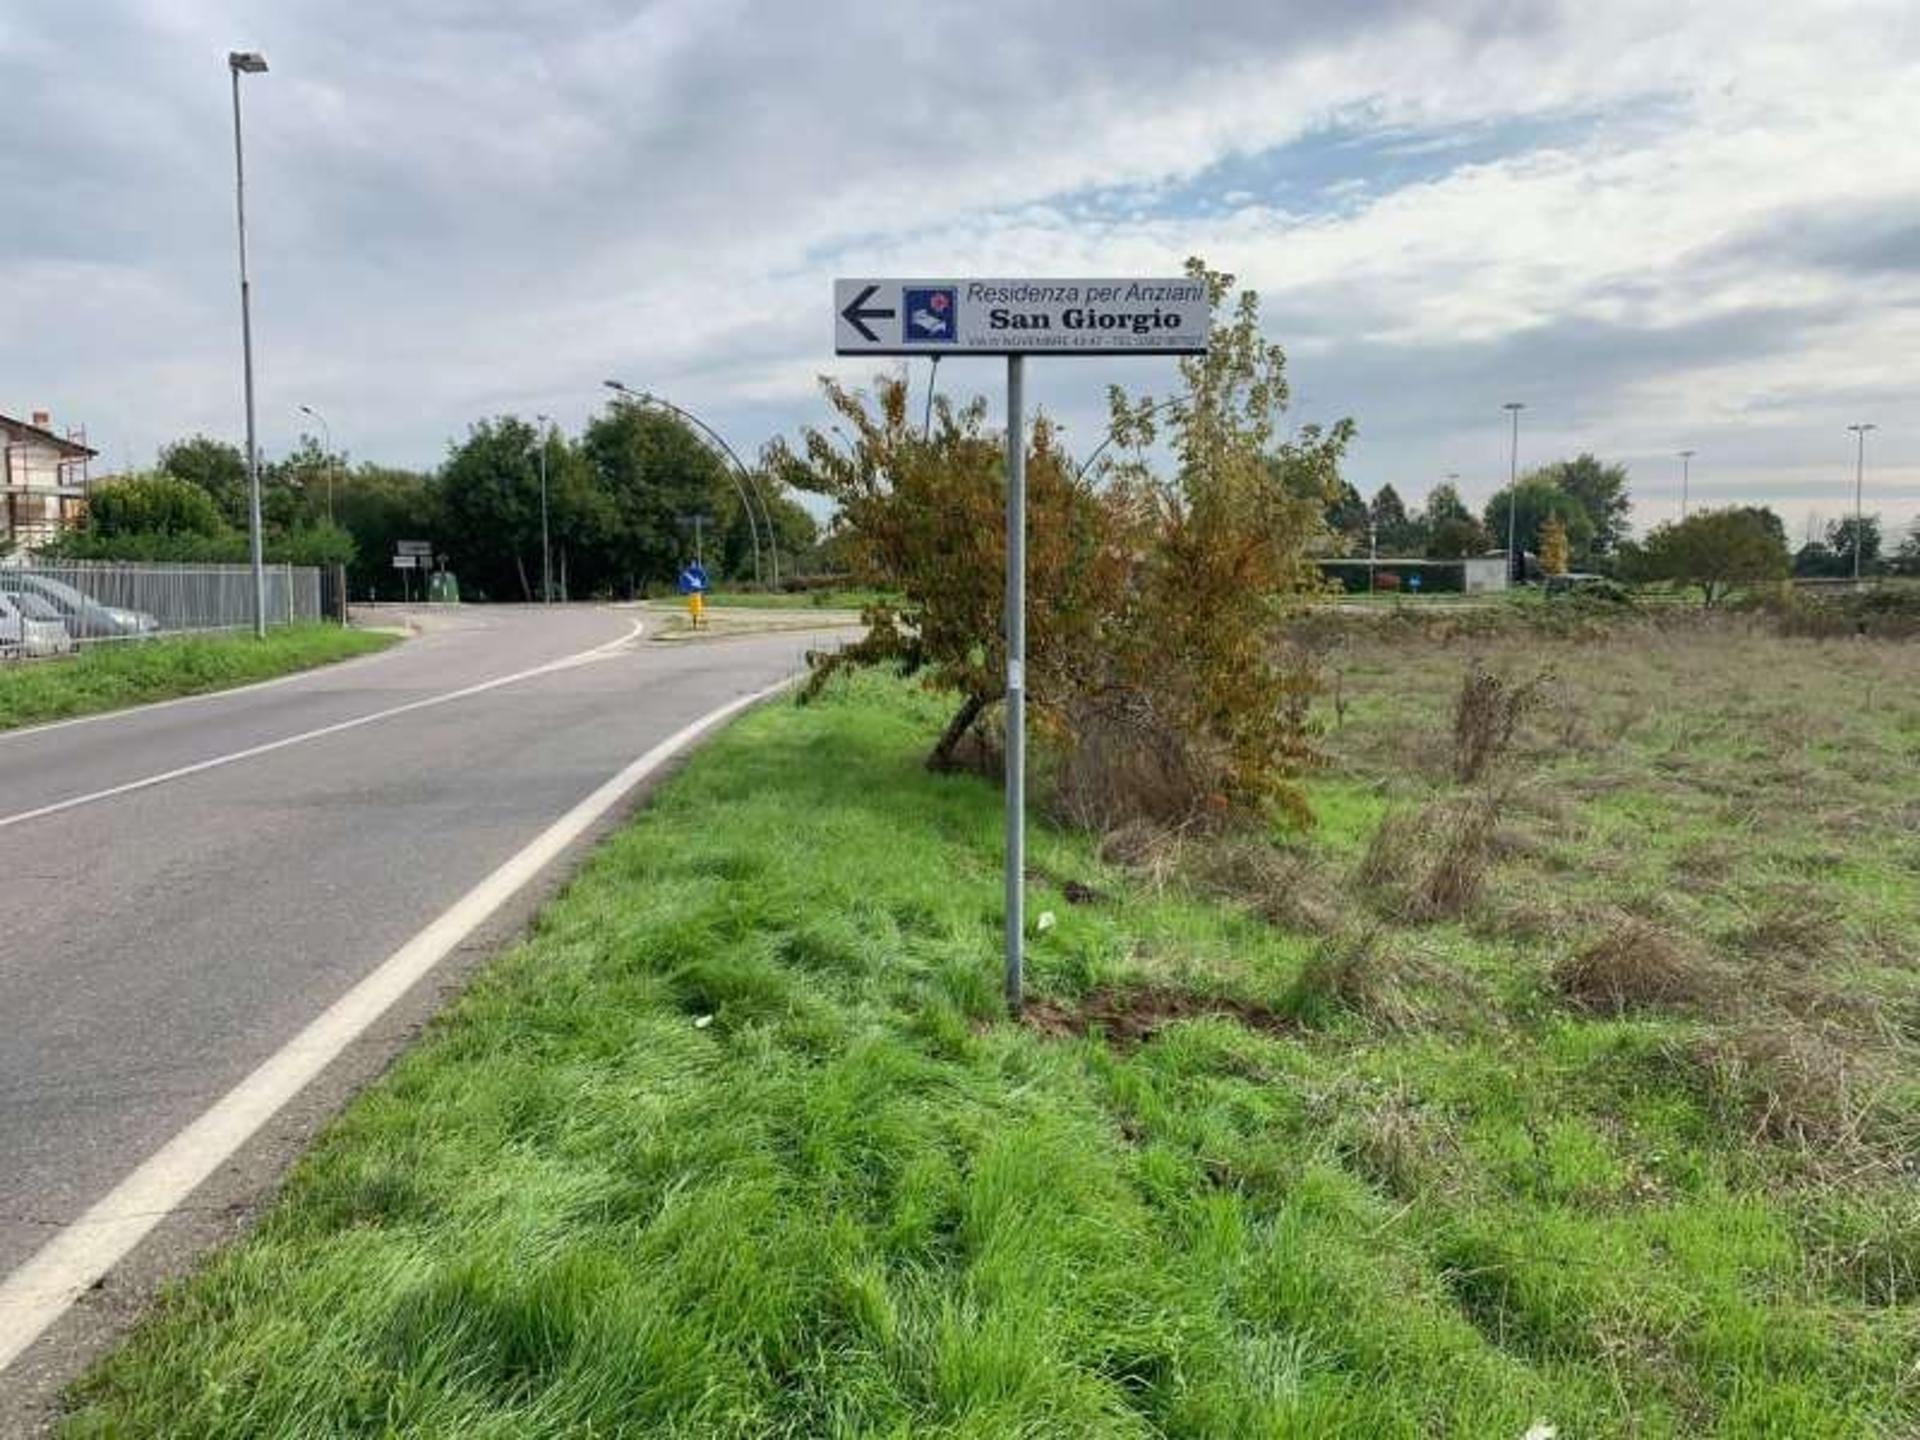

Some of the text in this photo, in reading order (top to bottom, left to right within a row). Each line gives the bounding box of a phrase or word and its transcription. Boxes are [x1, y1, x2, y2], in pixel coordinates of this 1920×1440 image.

[966, 281, 1204, 305] Residenza per Anziani
[990, 308, 1182, 334] San Giorgio
